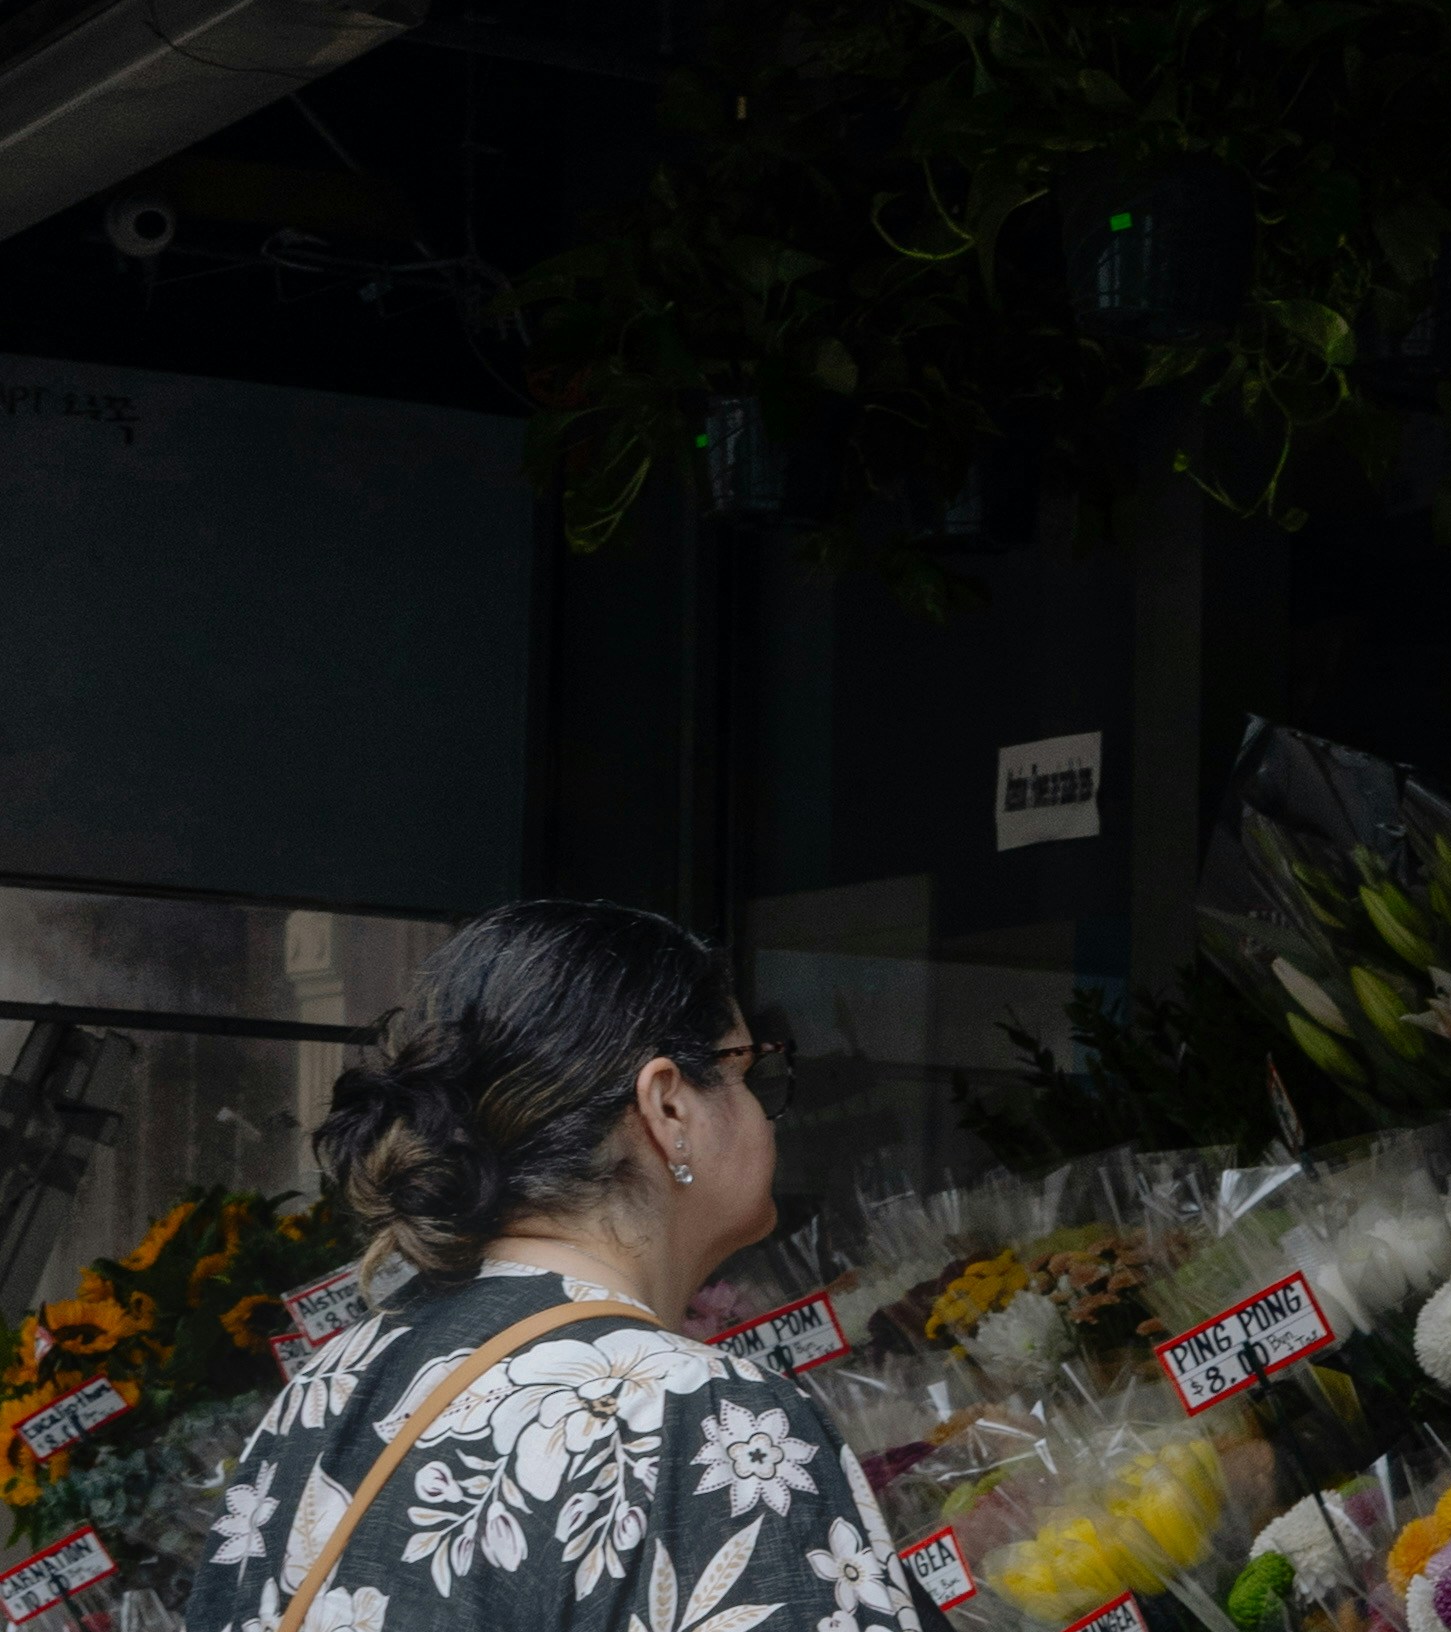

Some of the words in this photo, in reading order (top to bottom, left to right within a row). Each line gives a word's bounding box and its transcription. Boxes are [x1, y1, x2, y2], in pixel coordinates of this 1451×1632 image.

[771, 1303, 822, 1342] POM
[1169, 1322, 1231, 1375] PING
[1236, 1283, 1301, 1338] PONG
[0, 1536, 93, 1600] CARNATION
